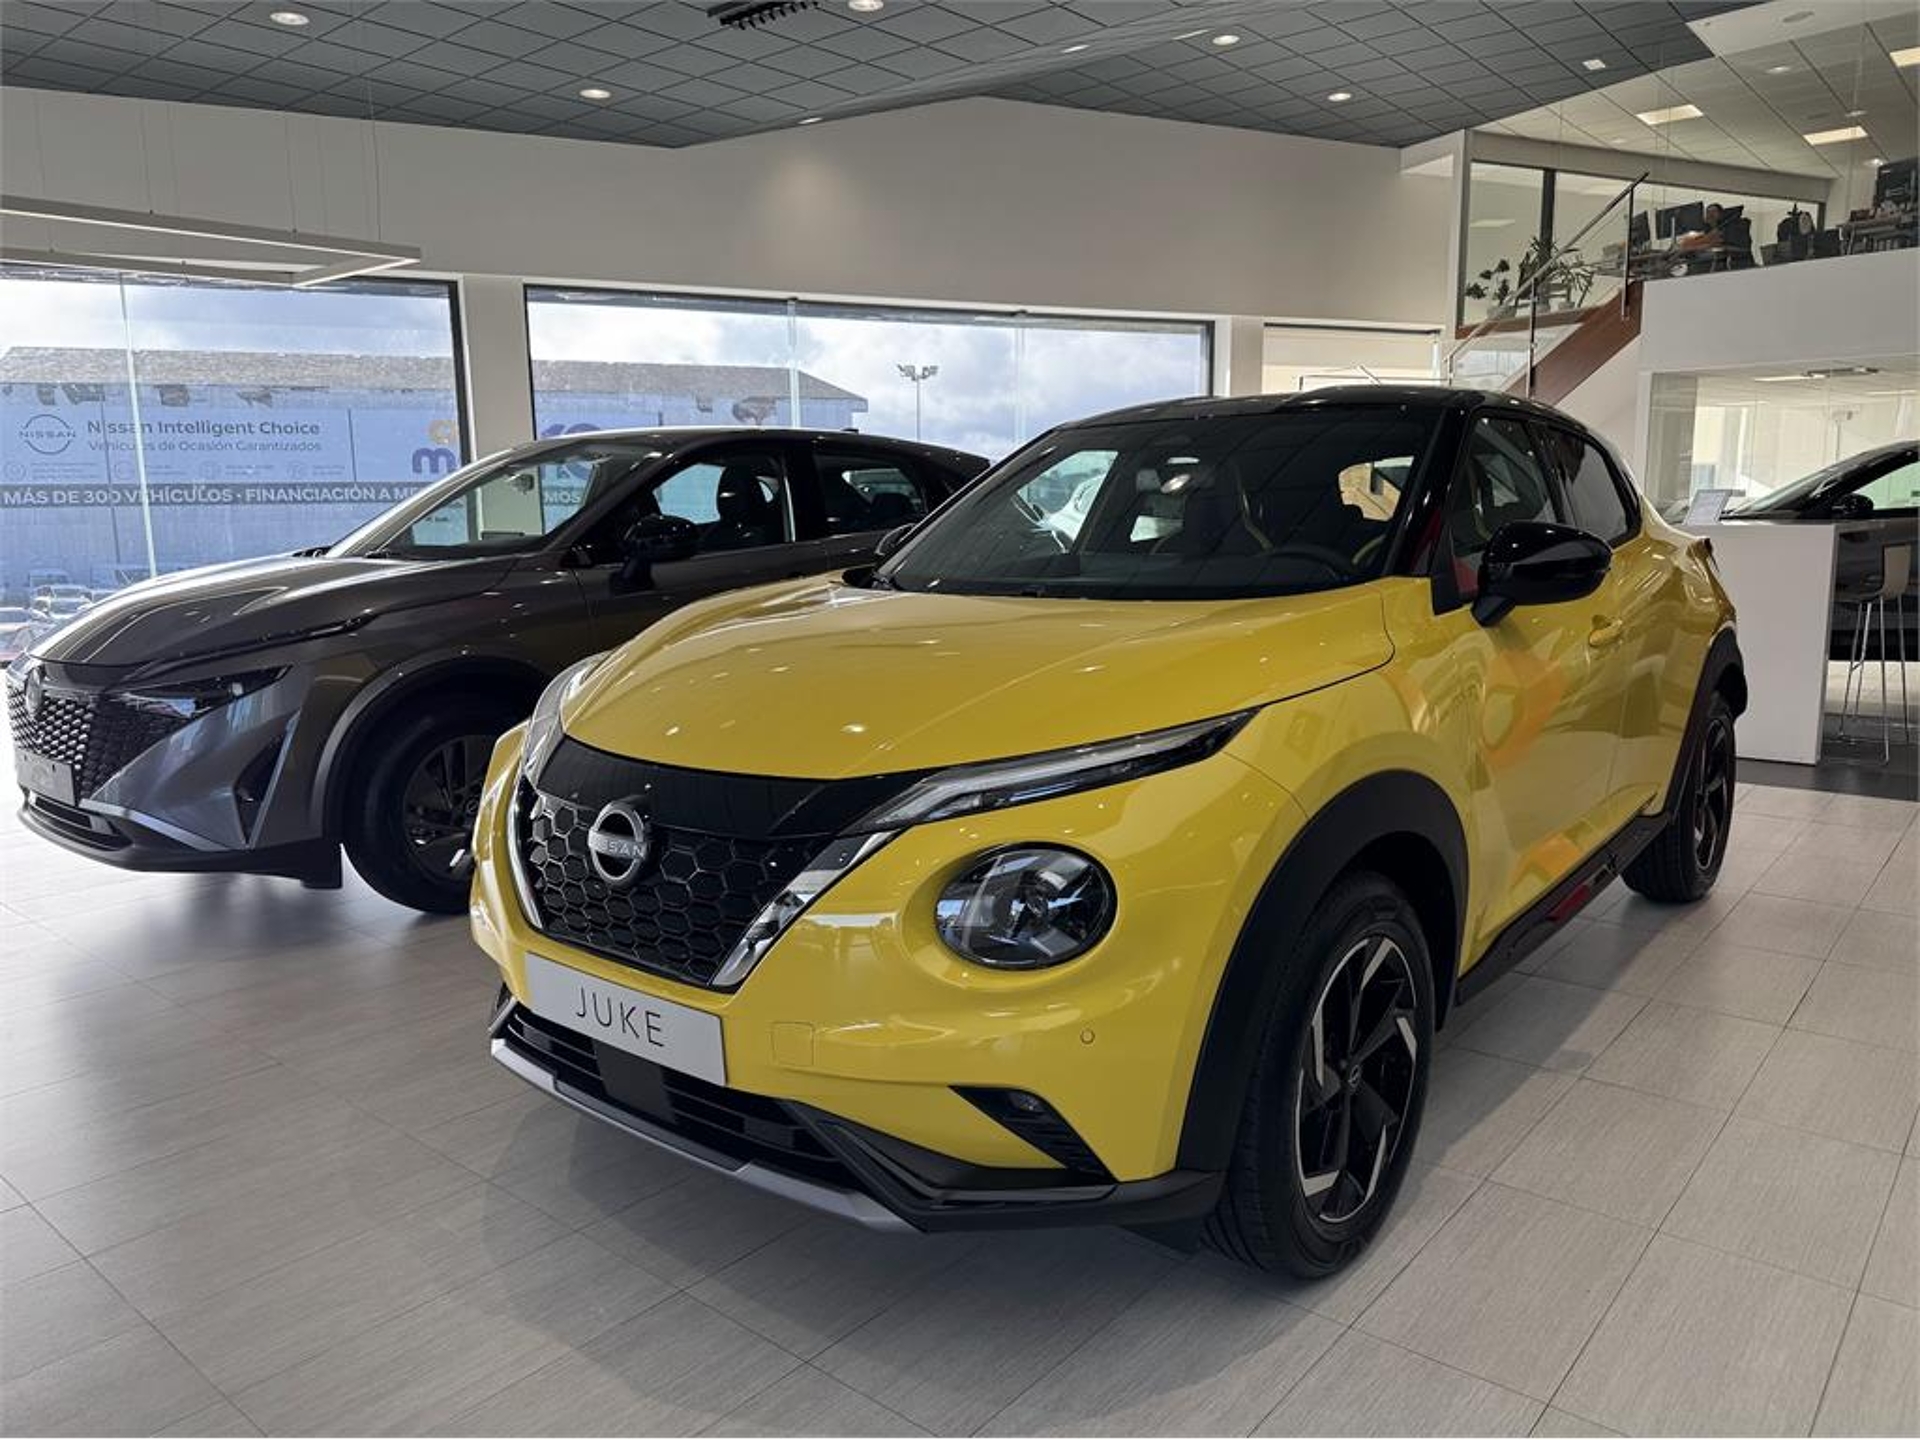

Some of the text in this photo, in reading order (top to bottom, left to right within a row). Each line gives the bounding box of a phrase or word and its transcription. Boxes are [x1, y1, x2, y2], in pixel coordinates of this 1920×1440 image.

[19, 430, 76, 439] NISSAN
[158, 419, 254, 437] Intelligent
[259, 420, 320, 435] Choice
[88, 439, 156, 451] Vehícus
[158, 439, 176, 451] de
[4, 486, 48, 504] MÁS
[53, 490, 81, 504] DE
[84, 489, 121, 503] 300
[246, 485, 376, 501] FINANCIACIÓN
[378, 487, 392, 500] A
[576, 987, 664, 1047] JUKE
